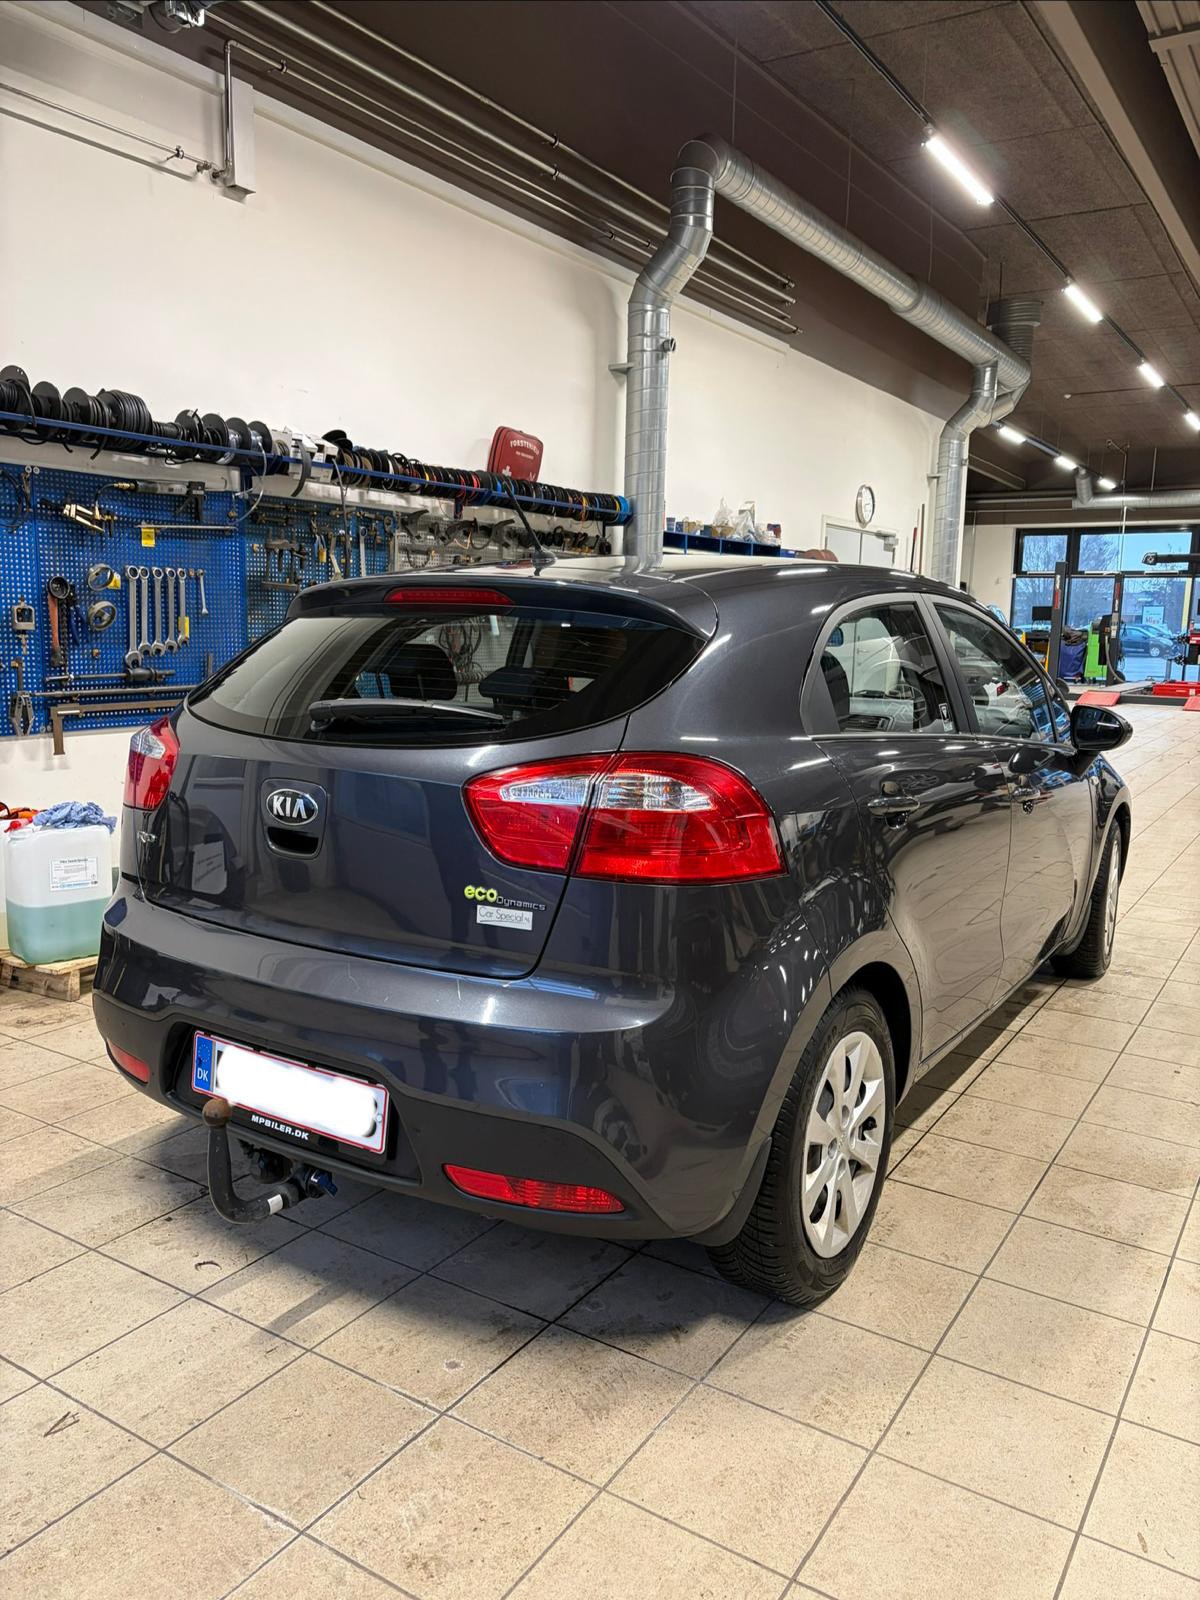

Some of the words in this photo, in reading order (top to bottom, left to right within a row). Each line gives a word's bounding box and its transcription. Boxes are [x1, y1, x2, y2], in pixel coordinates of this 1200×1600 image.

[273, 795, 308, 819] KIA
[464, 885, 498, 903] eco
[479, 906, 494, 918] Car
[197, 1067, 209, 1082] DK
[251, 1114, 309, 1140] MPBILER.DK
